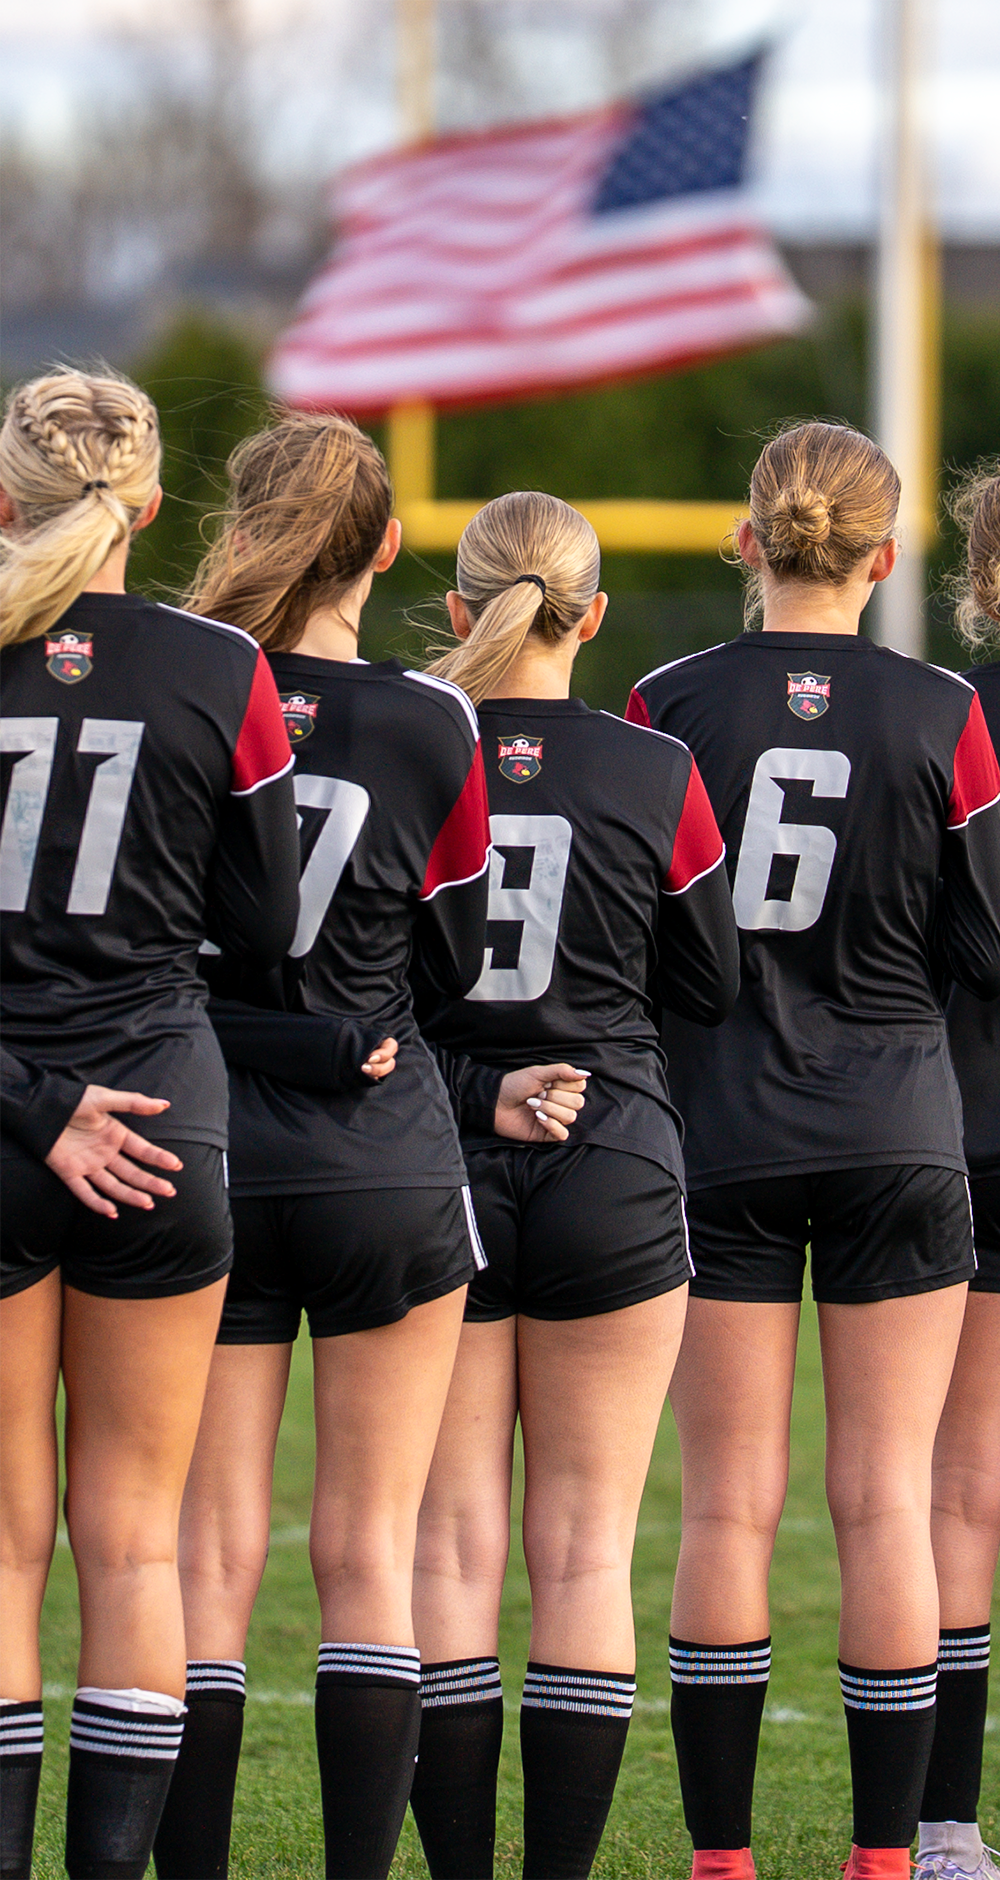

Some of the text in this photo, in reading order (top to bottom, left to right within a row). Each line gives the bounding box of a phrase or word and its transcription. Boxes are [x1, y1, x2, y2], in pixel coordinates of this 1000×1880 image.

[499, 747, 541, 757] DE PERE
[789, 682, 828, 694] DE PERE
[0, 716, 145, 915] 11
[463, 814, 573, 1001] 9
[732, 747, 851, 932] 6
